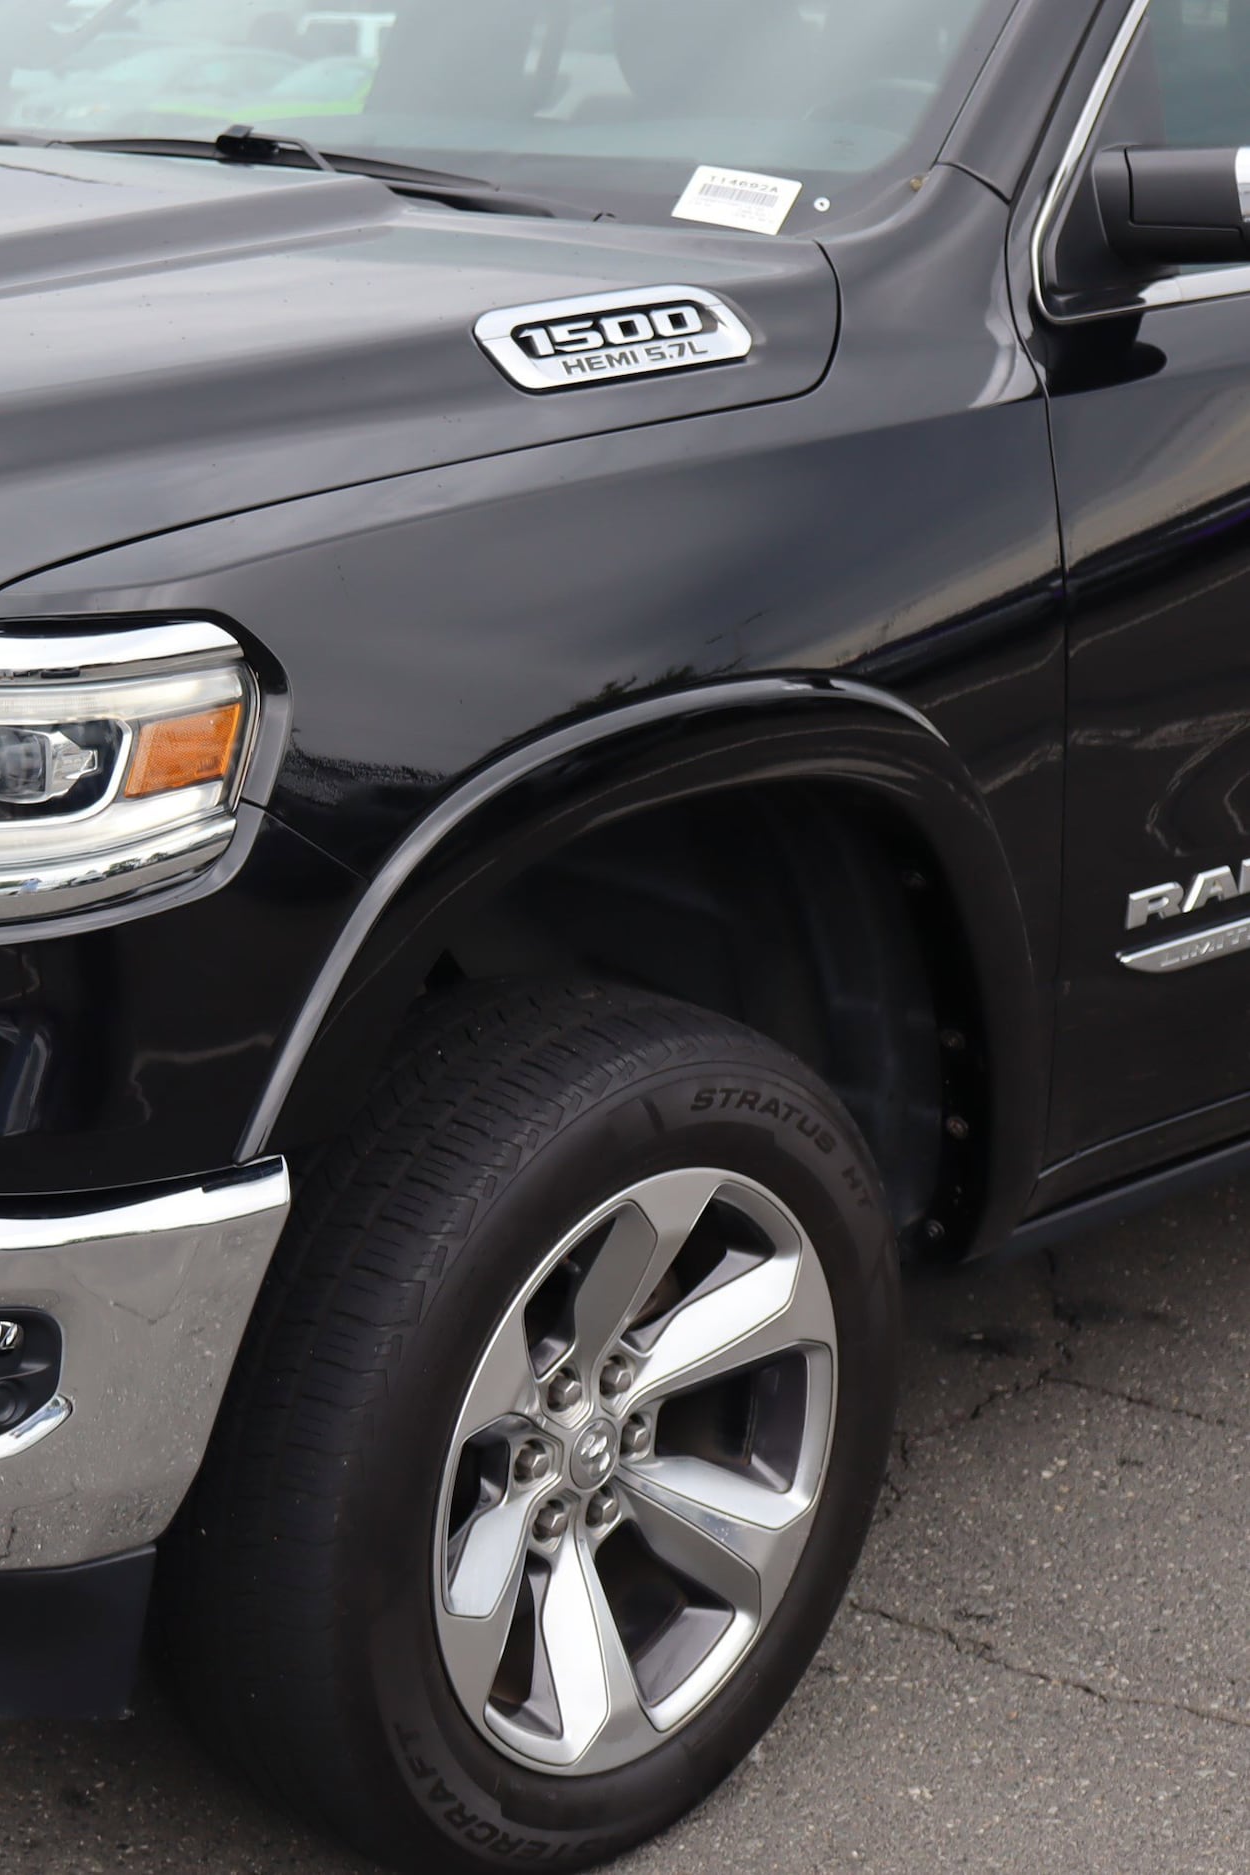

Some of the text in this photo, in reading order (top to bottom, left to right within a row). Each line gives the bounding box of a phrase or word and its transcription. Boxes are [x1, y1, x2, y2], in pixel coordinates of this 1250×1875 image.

[517, 305, 703, 356] 1500
[561, 341, 709, 376] HEMI 5.7L
[1124, 858, 1250, 931] RA
[1159, 926, 1250, 968] LIMIT
[690, 1087, 837, 1154] STRATUS
